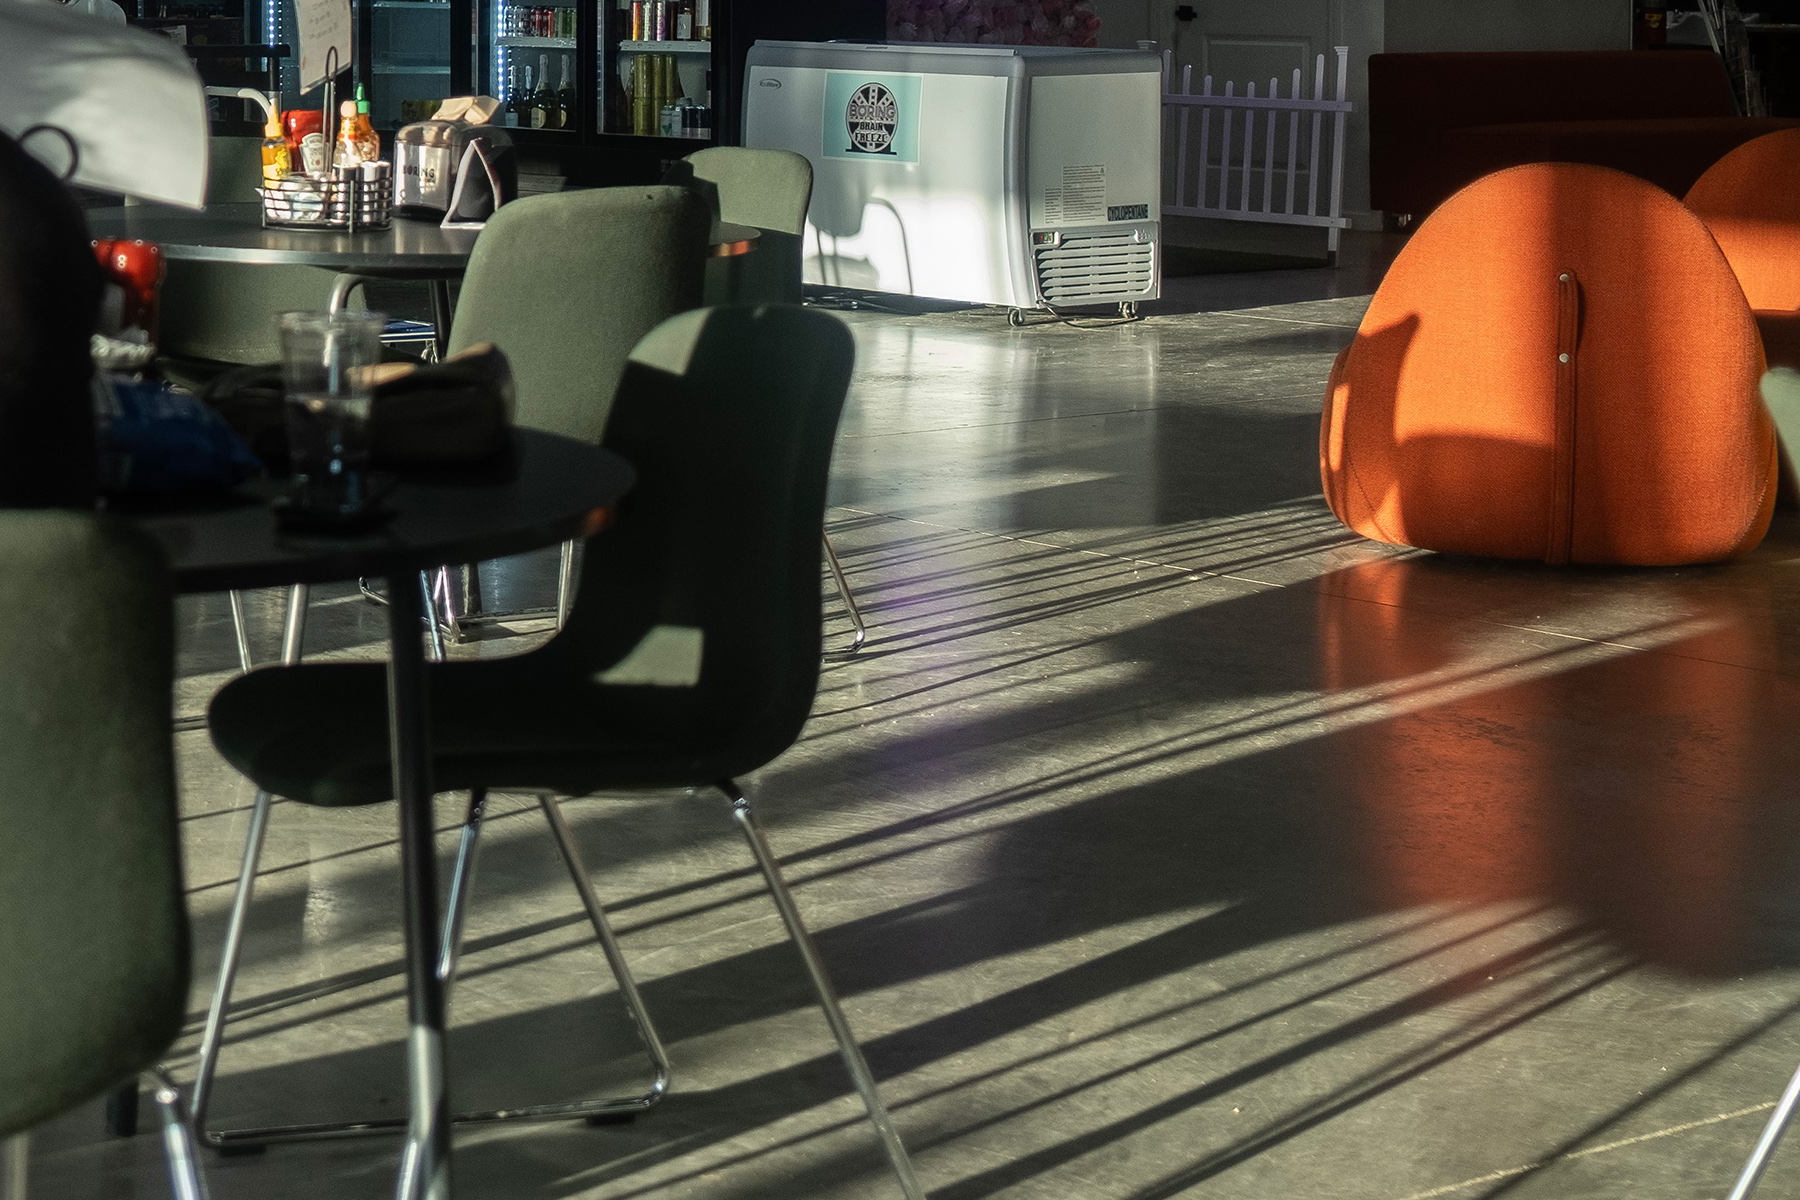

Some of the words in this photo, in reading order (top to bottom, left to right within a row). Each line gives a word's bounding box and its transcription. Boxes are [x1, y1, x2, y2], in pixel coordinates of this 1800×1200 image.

[849, 103, 896, 119] BORING
[859, 121, 884, 131] BRAIN
[854, 131, 888, 143] FREEZE
